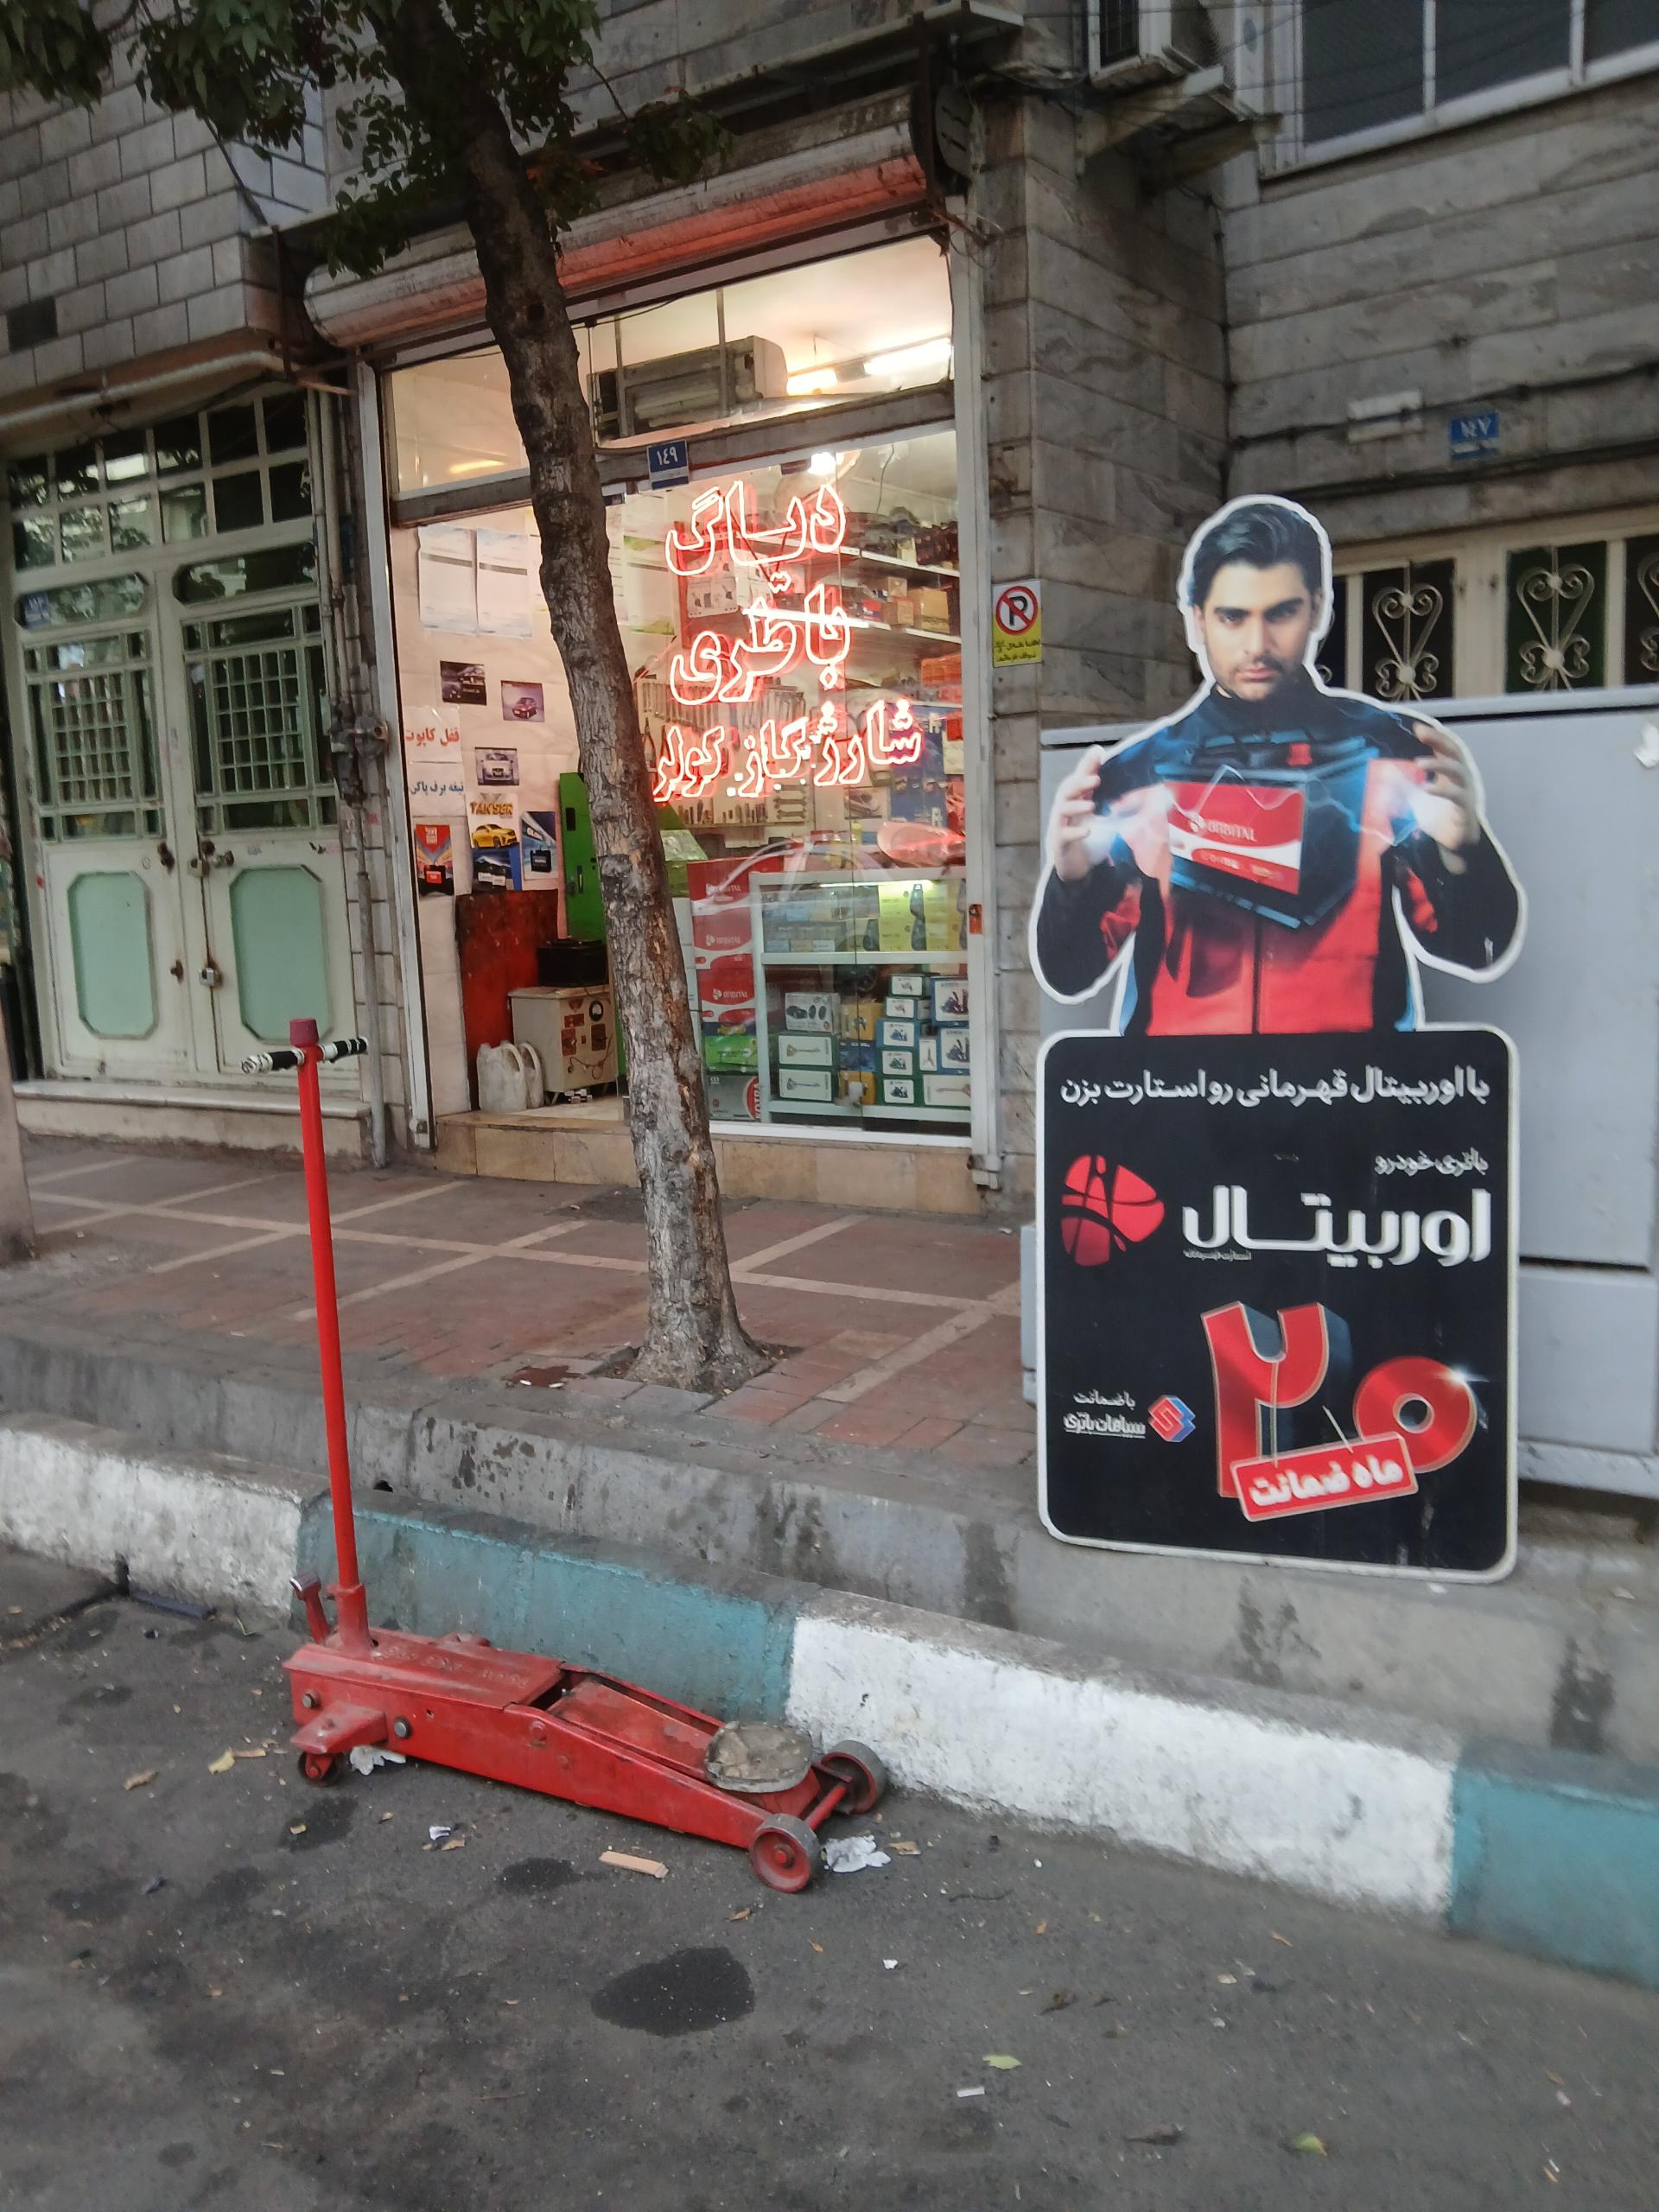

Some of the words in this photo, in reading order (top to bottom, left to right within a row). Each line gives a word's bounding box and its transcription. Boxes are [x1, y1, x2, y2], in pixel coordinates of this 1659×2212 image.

[670, 582, 851, 706] باطری
[440, 727, 460, 747] قفل
[810, 696, 922, 786] شارژ
[1208, 820, 1258, 842] ORBITAL
[1060, 1078, 1102, 1107] بزن
[1103, 1068, 1207, 1105] استارت
[1207, 1081, 1234, 1106] رو
[1236, 1067, 1348, 1108] قهرمانی
[1350, 1064, 1464, 1106] اوربیتال
[1466, 1065, 1491, 1105] با
[1374, 1149, 1435, 1177] خودرو
[1434, 1147, 1490, 1177] باتری
[1181, 1184, 1492, 1268] اوربیتال
[1073, 1389, 1124, 1407] ضمانت
[1123, 1389, 1136, 1410] با
[1248, 1460, 1351, 1507] ضمانت
[1351, 1454, 1404, 1489] ماه
